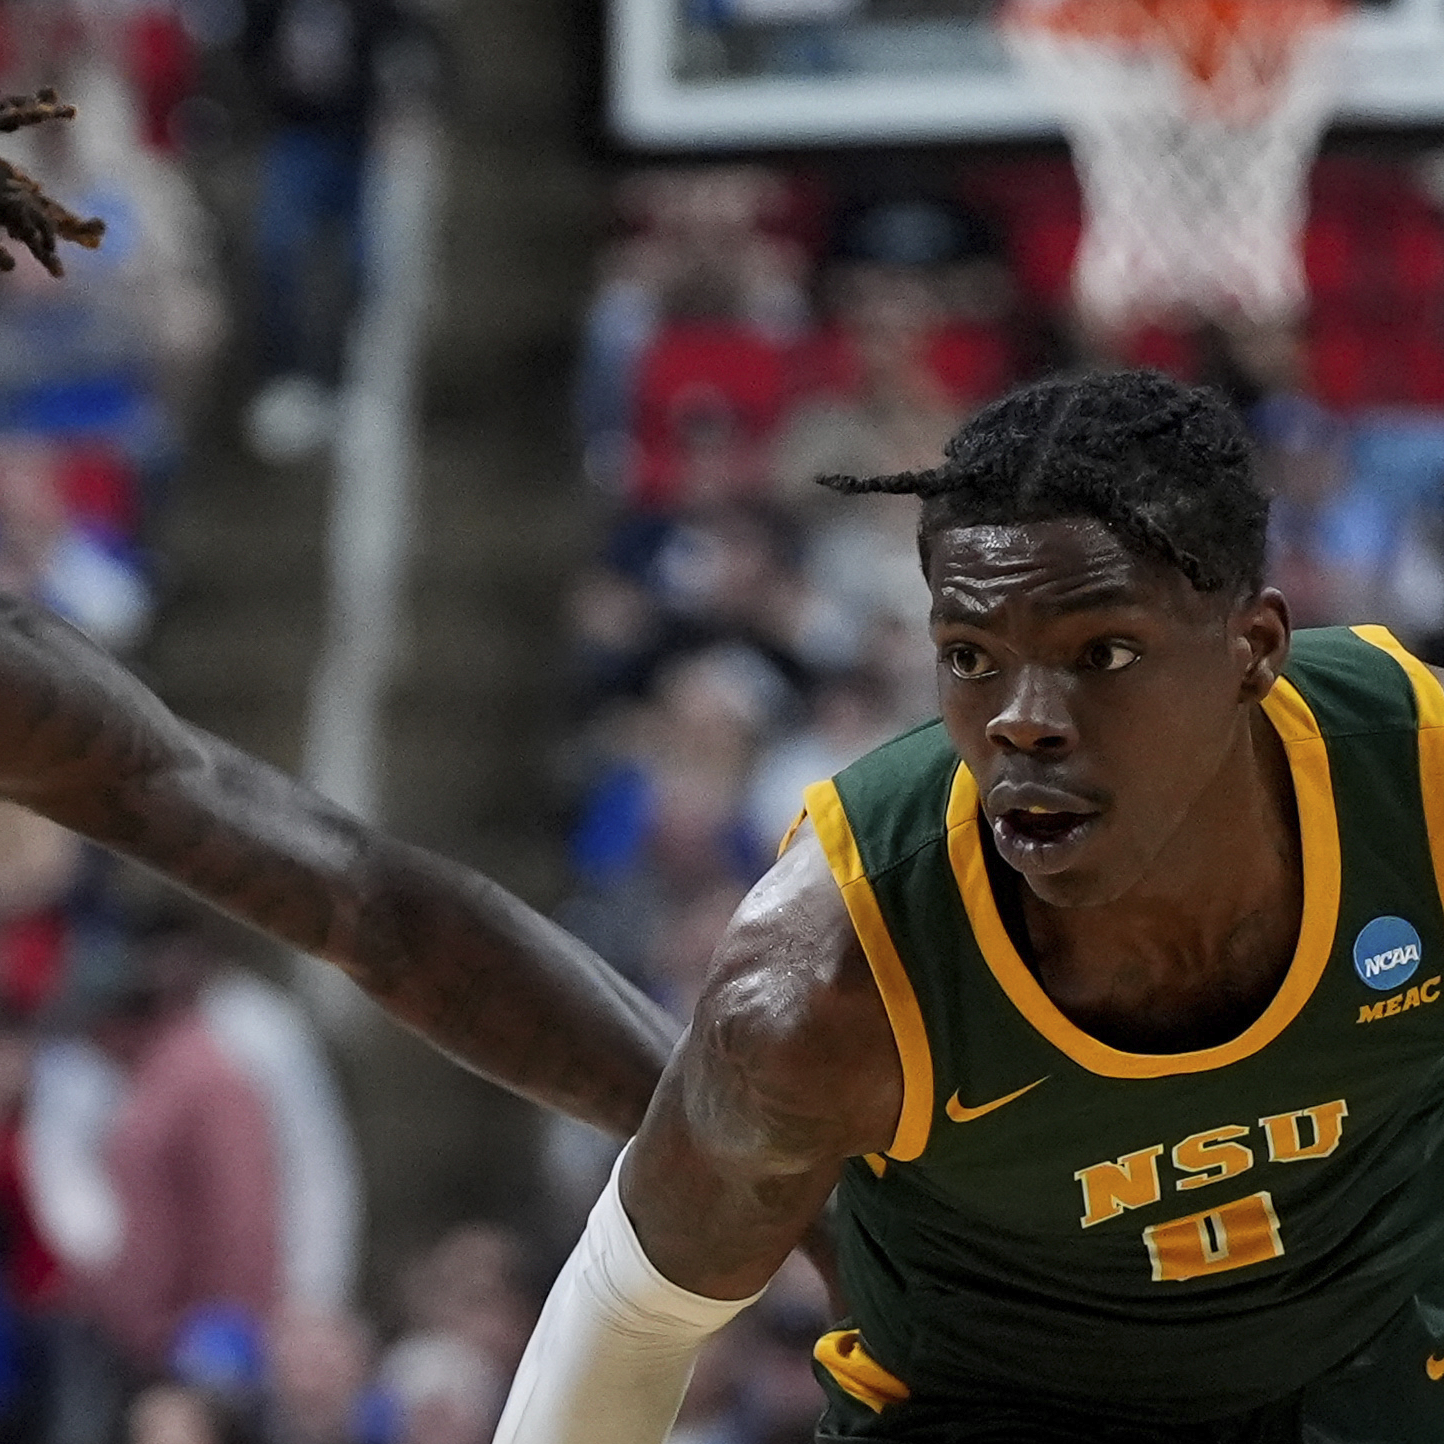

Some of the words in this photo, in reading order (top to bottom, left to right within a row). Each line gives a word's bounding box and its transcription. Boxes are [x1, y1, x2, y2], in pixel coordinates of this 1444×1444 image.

[1364, 943, 1420, 978] NCAA
[1356, 974, 1442, 1024] MEAC
[1073, 1099, 1349, 1229] NSU
